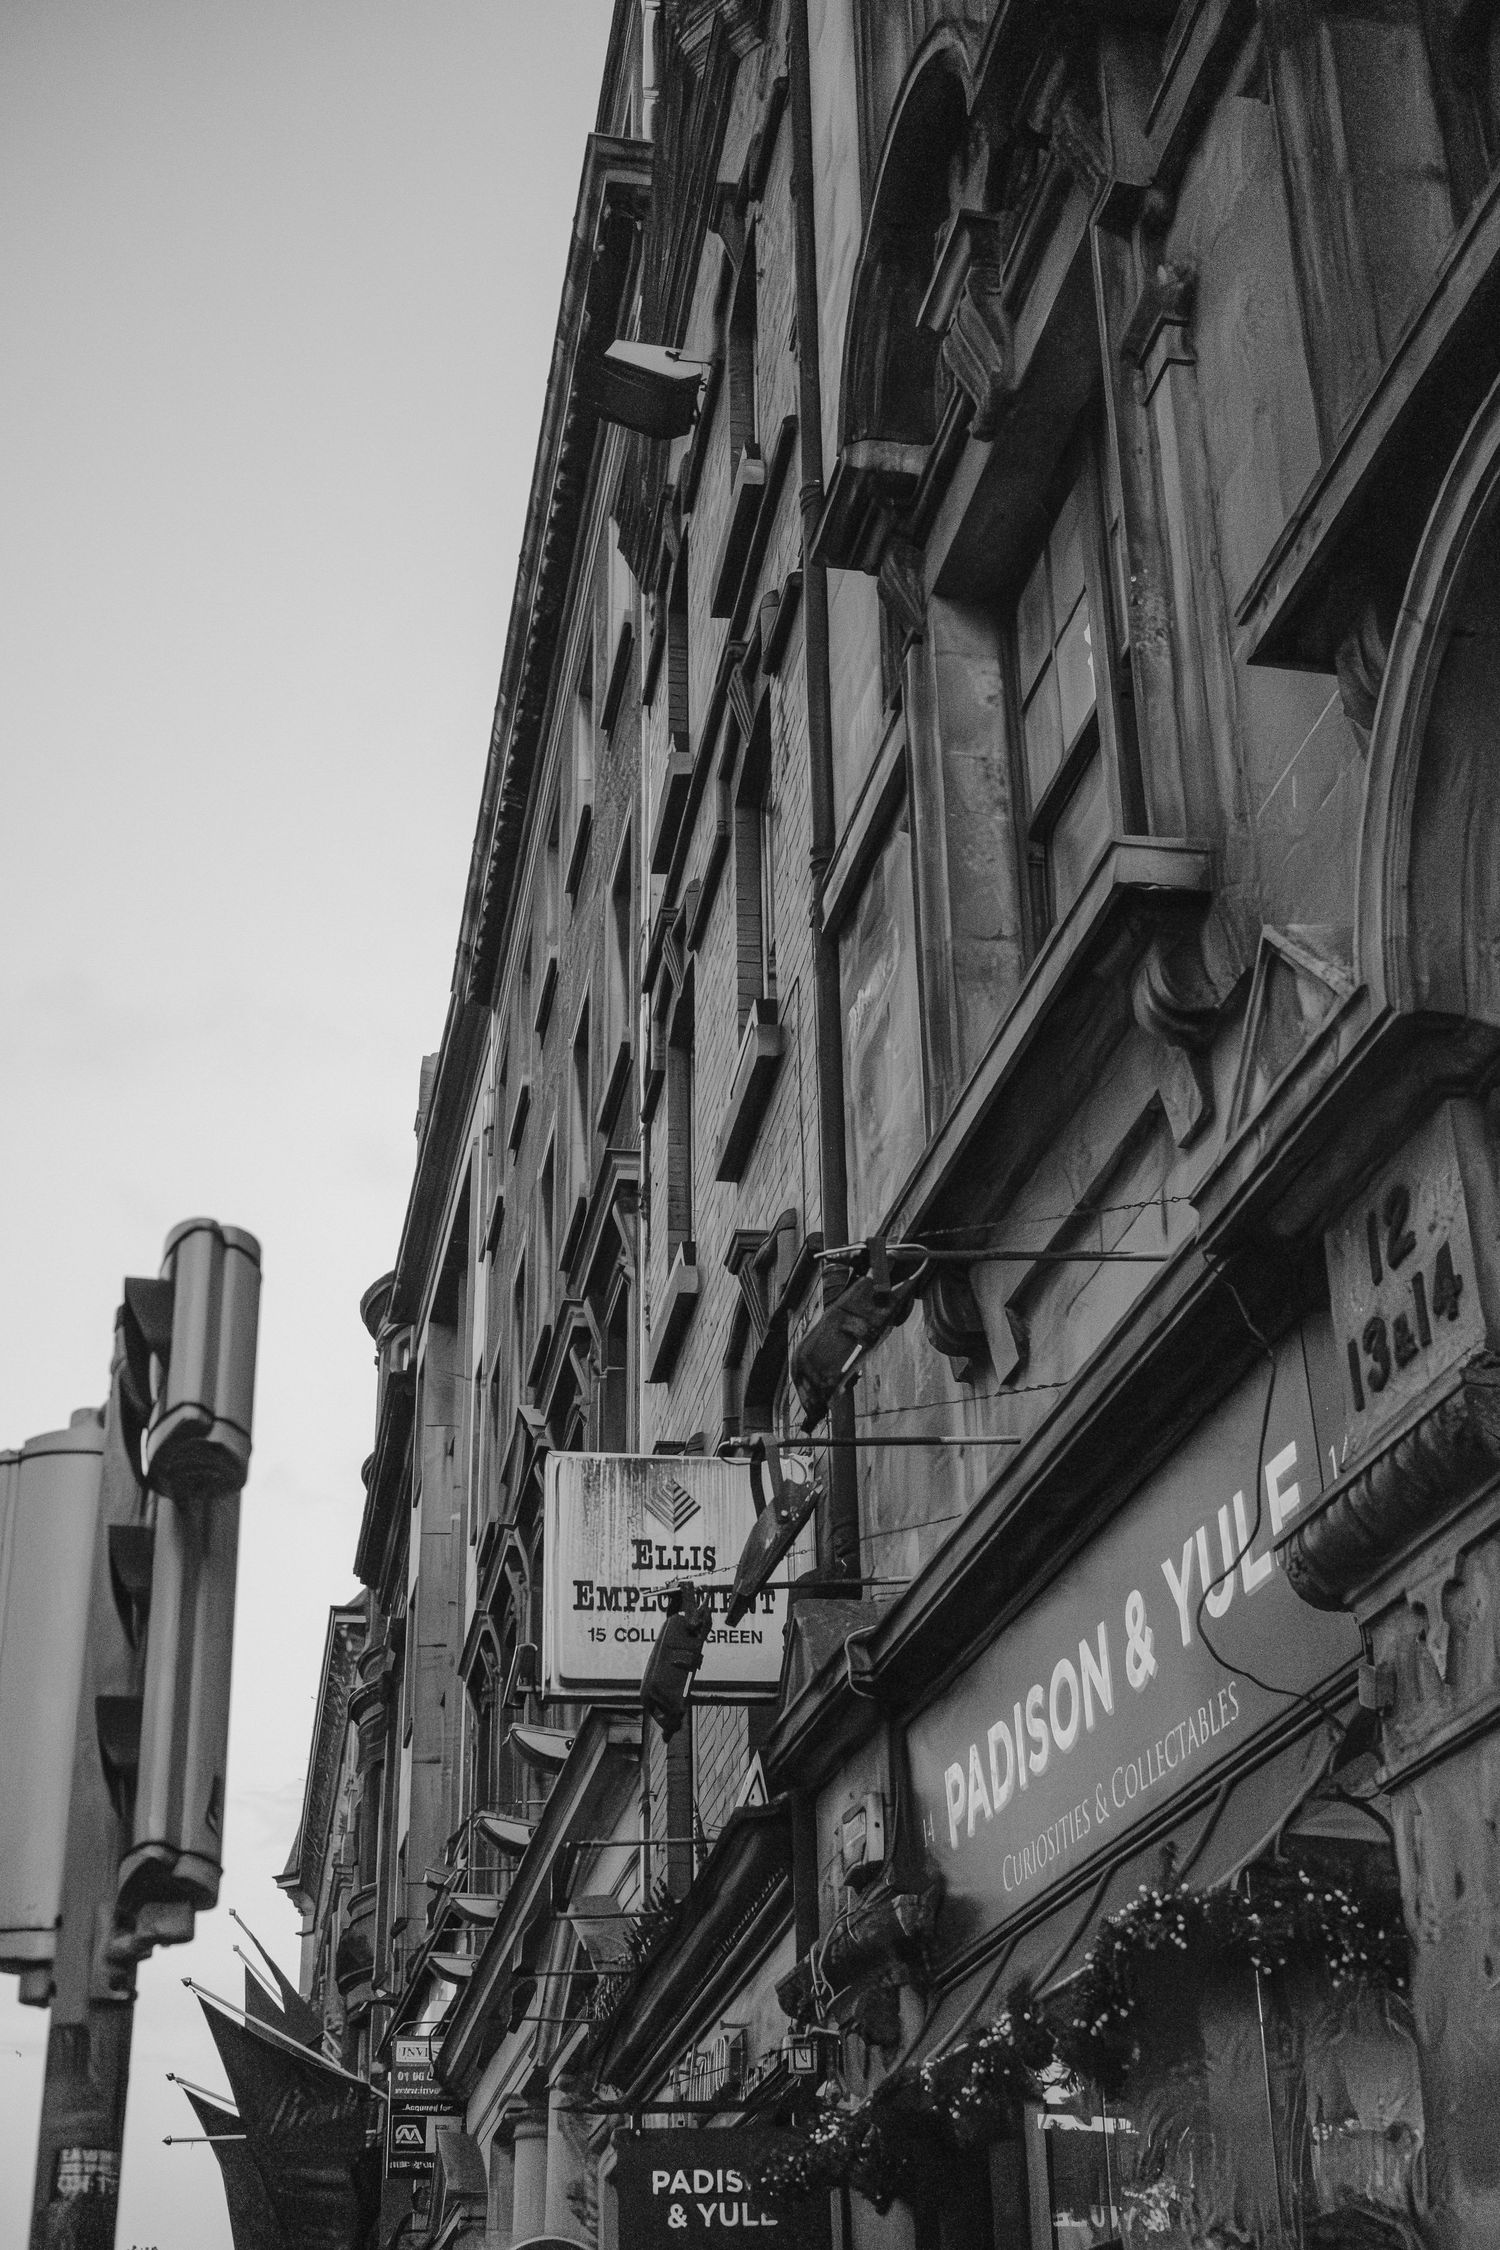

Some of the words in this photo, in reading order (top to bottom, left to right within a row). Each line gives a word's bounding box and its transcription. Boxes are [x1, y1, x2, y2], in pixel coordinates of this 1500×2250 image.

[1366, 1184, 1417, 1287] 12
[588, 1627, 607, 1643] 15
[705, 1629, 763, 1645] GREEN
[944, 1621, 1114, 1850] PADISON
[1125, 1589, 1159, 1693] &
[1160, 1439, 1301, 1649] YULE
[1002, 1799, 1092, 1893] CURIOSITIES
[1095, 1782, 1110, 1824] &
[1111, 1680, 1239, 1809] COLLECTABLES
[652, 2168, 744, 2196] PADIS
[667, 2203, 688, 2229] &
